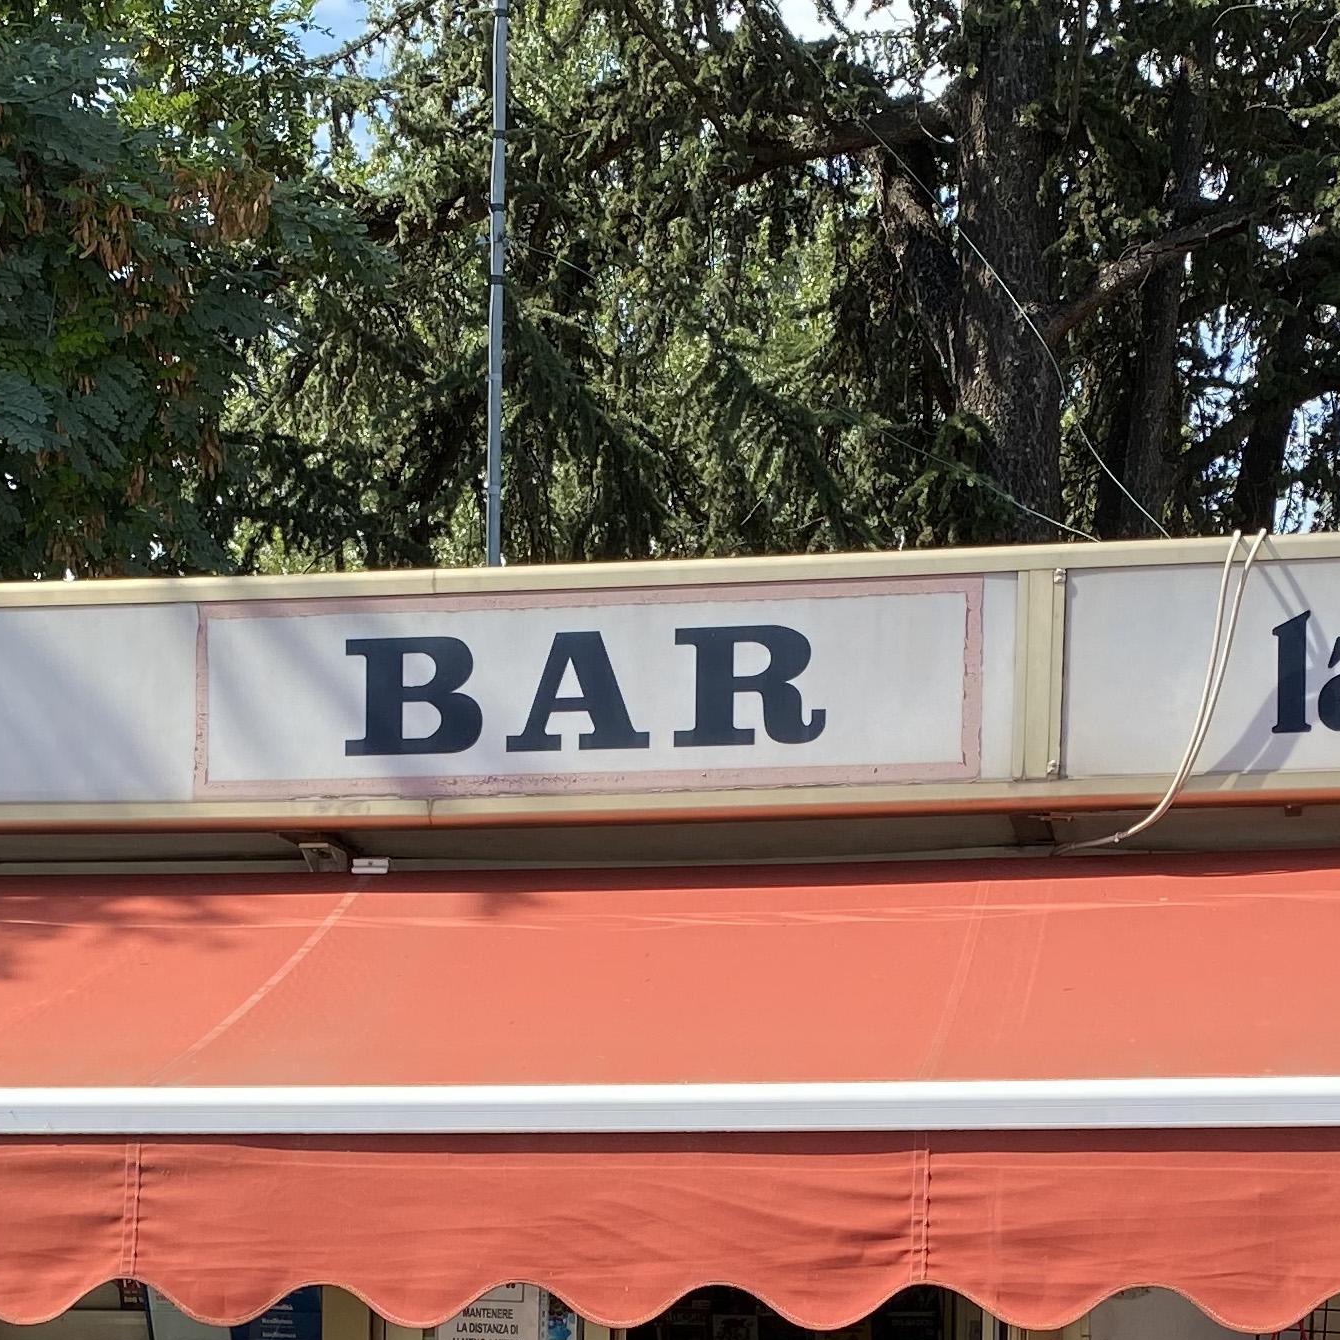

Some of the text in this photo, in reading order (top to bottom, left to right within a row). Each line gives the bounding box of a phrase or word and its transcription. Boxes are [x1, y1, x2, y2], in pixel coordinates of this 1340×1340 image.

[345, 624, 826, 756] BAR
[462, 1308, 514, 1320] MANTENERE
[456, 1323, 519, 1335] LA DISTANZA DI
